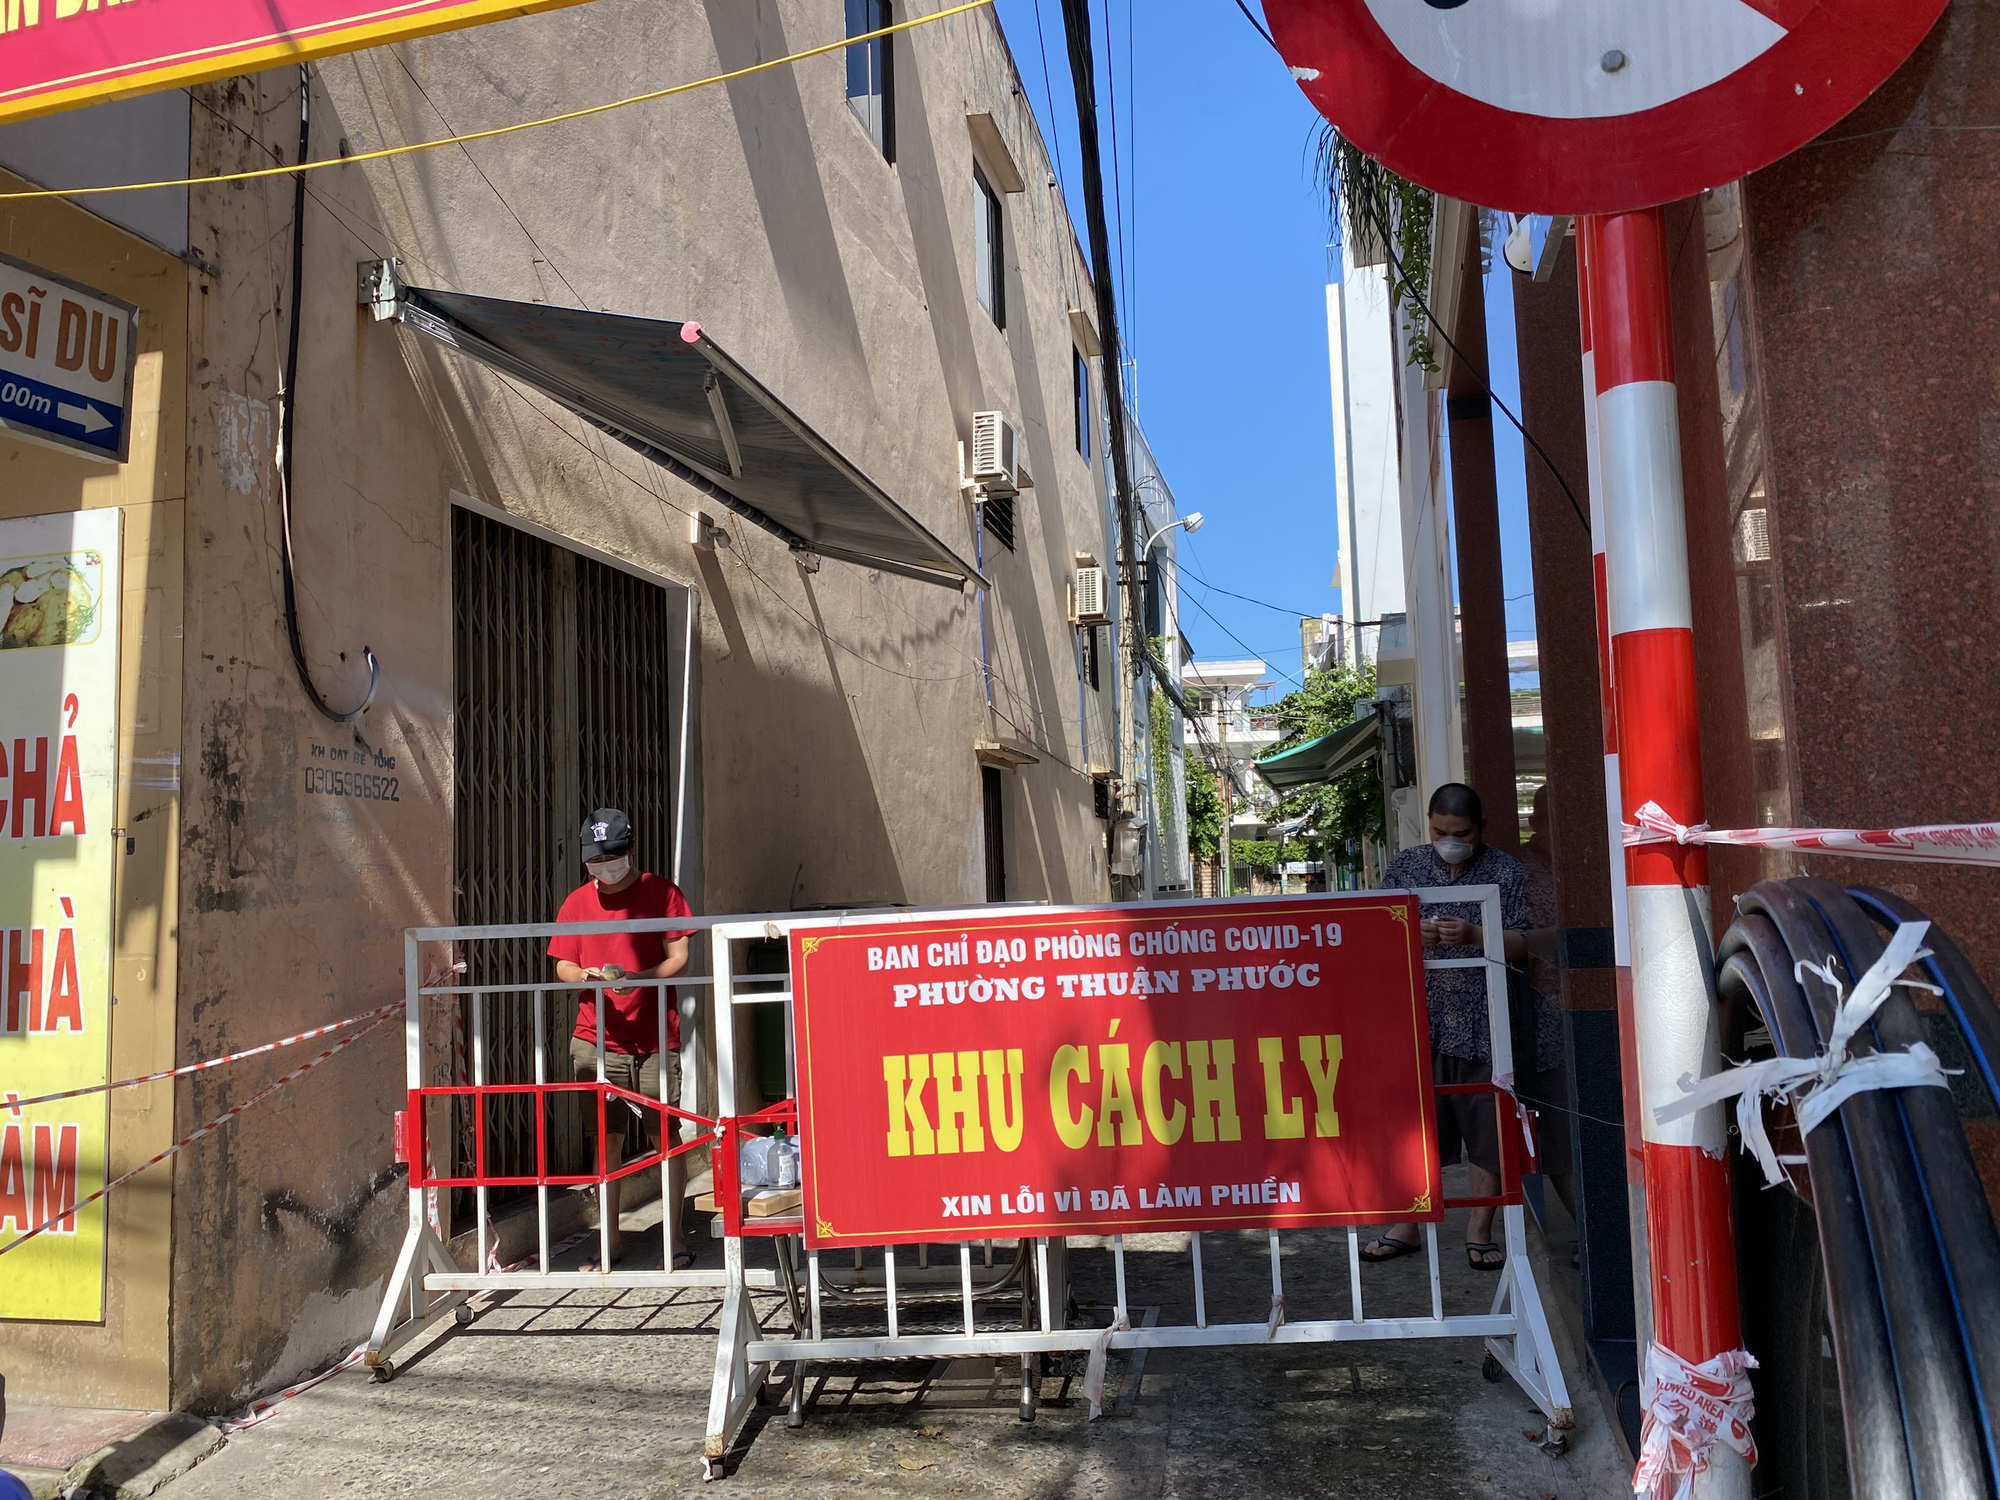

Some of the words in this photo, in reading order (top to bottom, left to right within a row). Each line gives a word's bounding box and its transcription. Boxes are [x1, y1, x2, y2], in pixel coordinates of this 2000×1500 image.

[0, 285, 47, 360] SĨ
[55, 298, 119, 383] DU
[0, 382, 51, 414] 00m
[0, 693, 86, 838] HẢ
[0, 897, 82, 1031] HÀ
[867, 944, 920, 971] BAN
[927, 934, 969, 967] CHỈ
[976, 938, 1027, 968] ĐẠO
[1034, 930, 1121, 961] PHÒNG
[1129, 922, 1217, 956] CHỐNG
[1224, 922, 1343, 952] COVID-19
[893, 974, 1046, 1008] PHƯỜNG
[1056, 966, 1179, 1000] THUẬN
[1191, 959, 1321, 992] PHƯỚC
[883, 1048, 1024, 1157] KHU
[1049, 1019, 1242, 1149] CÁCH
[1258, 1034, 1344, 1139] LY
[941, 1194, 992, 1217] XIN
[1000, 1185, 1045, 1215] LỖI
[1053, 1186, 1082, 1212] VÌ
[1090, 1185, 1131, 1211] ĐÃ
[1138, 1182, 1202, 1209] LÀM
[1211, 1176, 1301, 1206] PHIỀN
[1694, 1395, 1725, 1422] AREA
